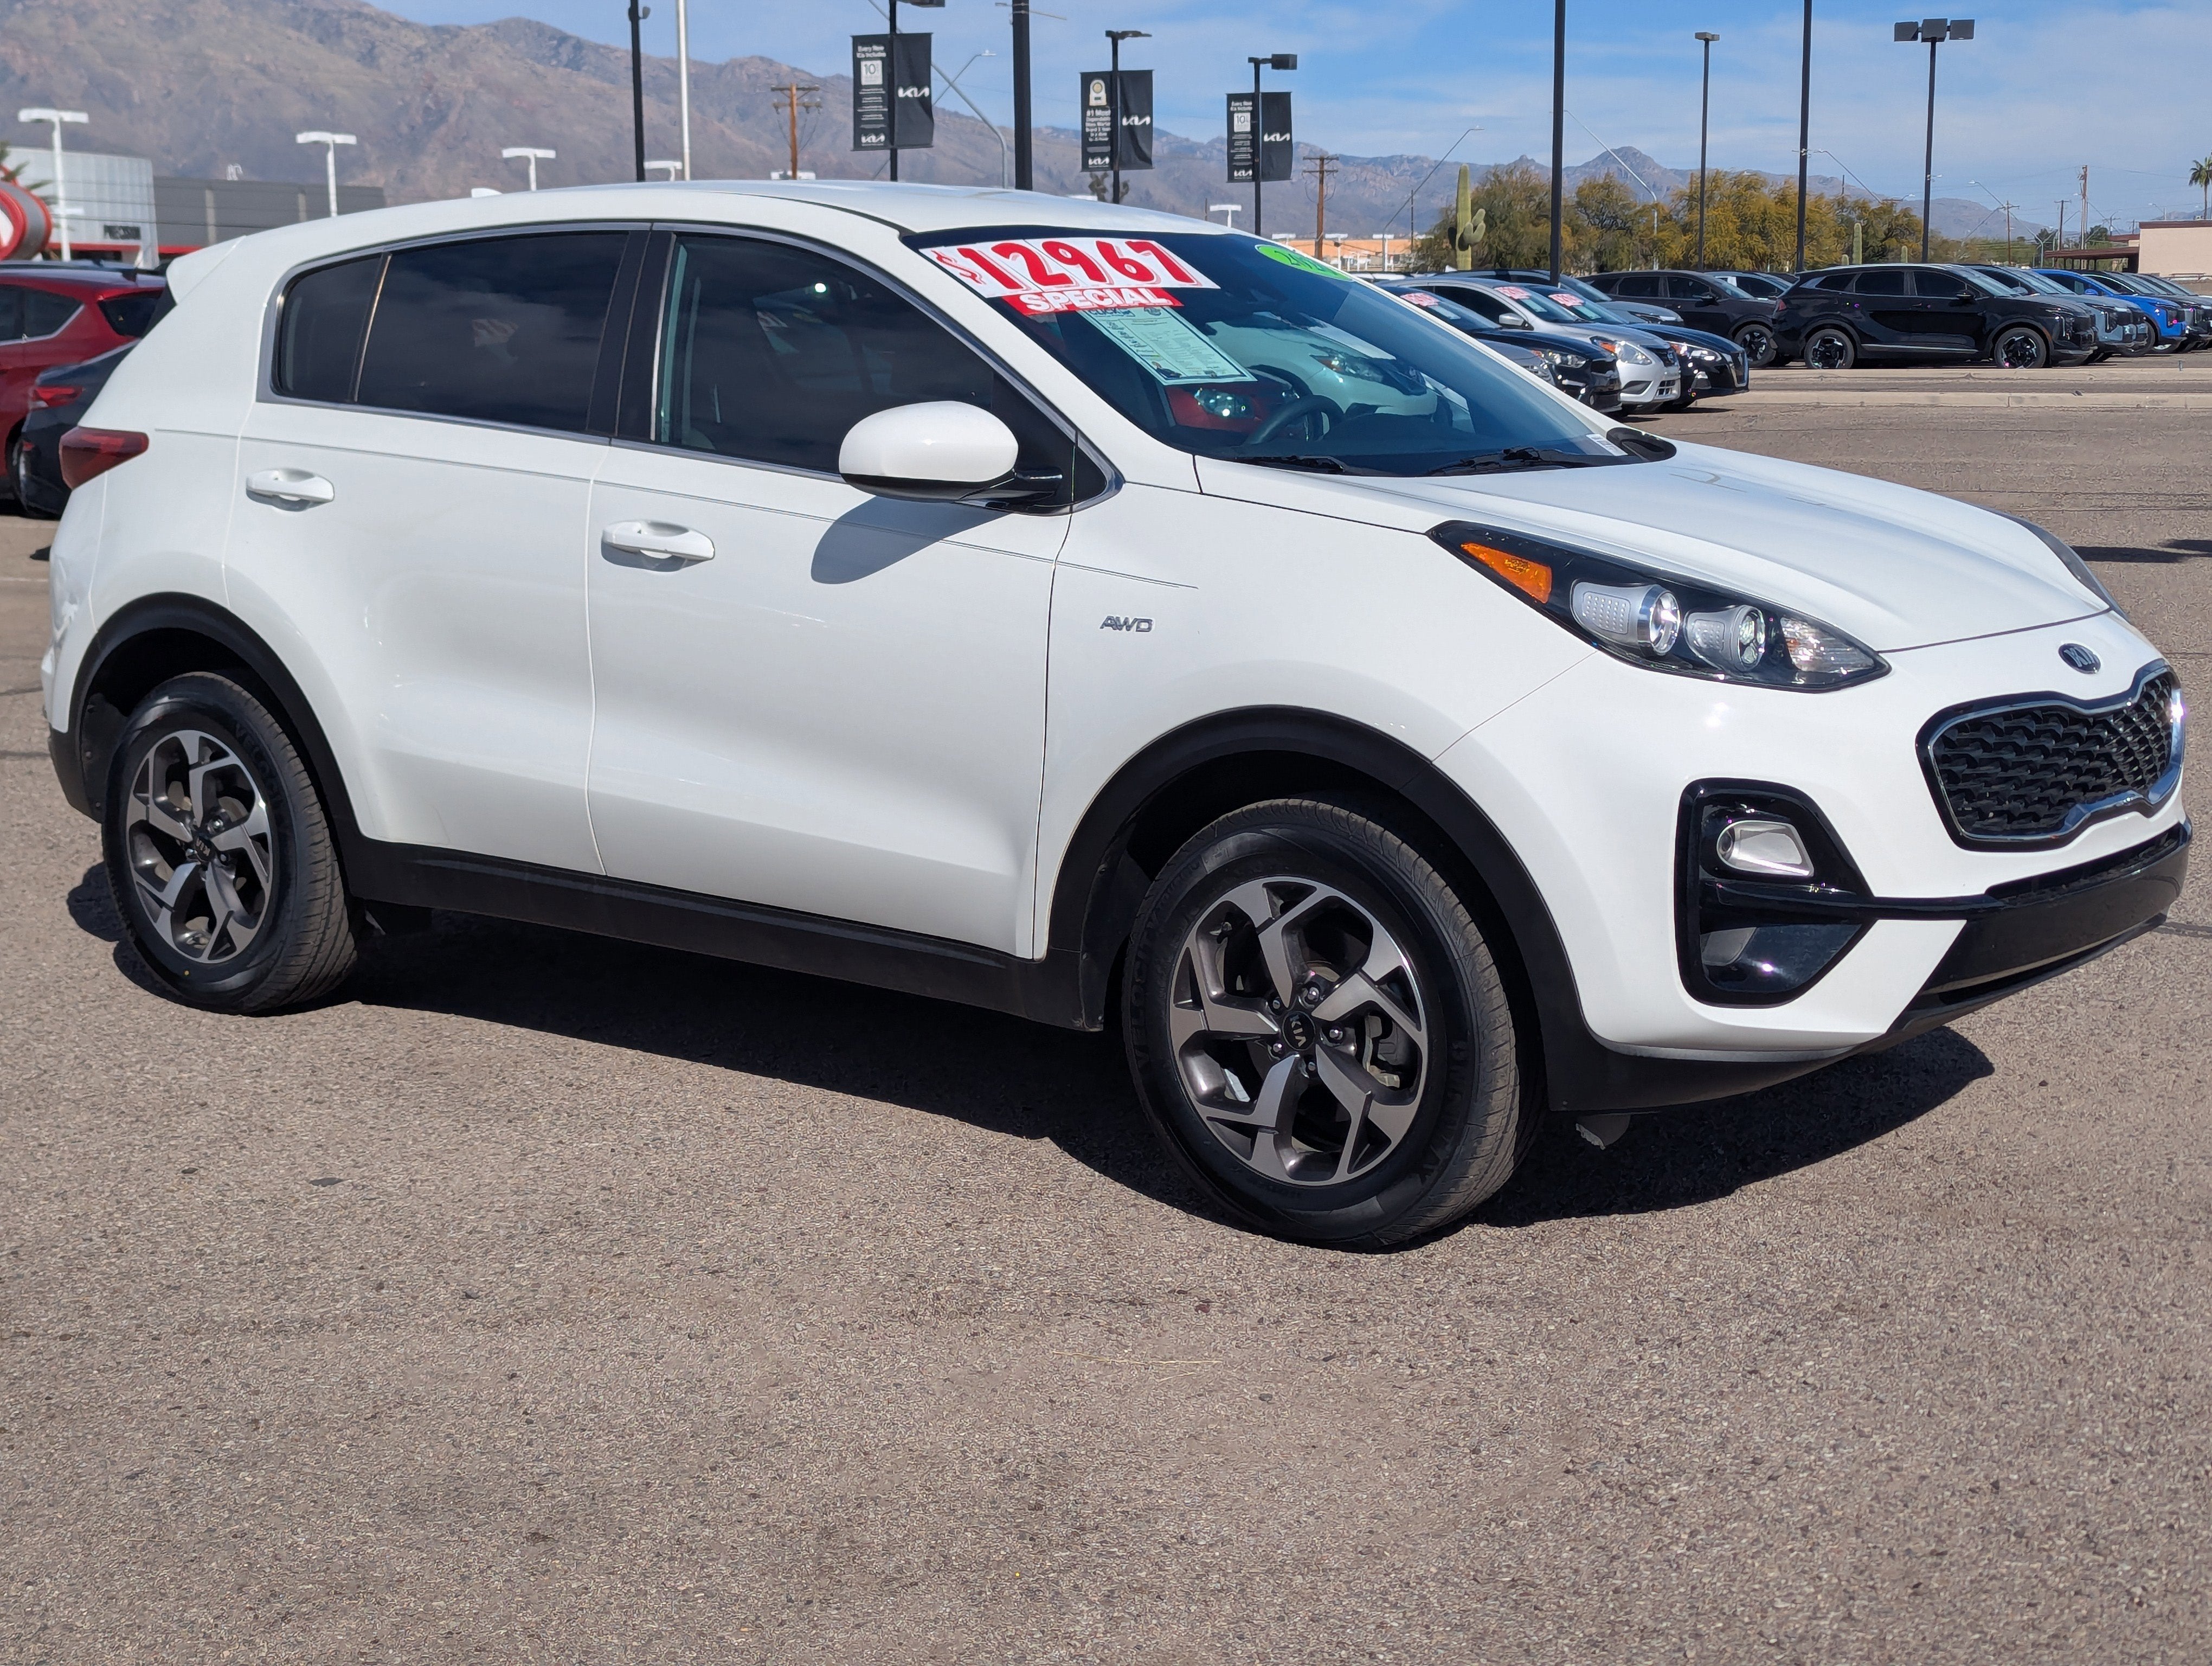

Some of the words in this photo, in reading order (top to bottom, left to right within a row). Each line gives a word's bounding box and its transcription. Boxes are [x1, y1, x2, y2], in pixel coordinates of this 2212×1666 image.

[864, 63, 876, 75] 10
[1237, 116, 1245, 124] 10
[931, 240, 1199, 291] $12967
[1025, 288, 1173, 313] SPECIAL
[1100, 615, 1153, 633] AWD
[1290, 1014, 1307, 1047] KIA
